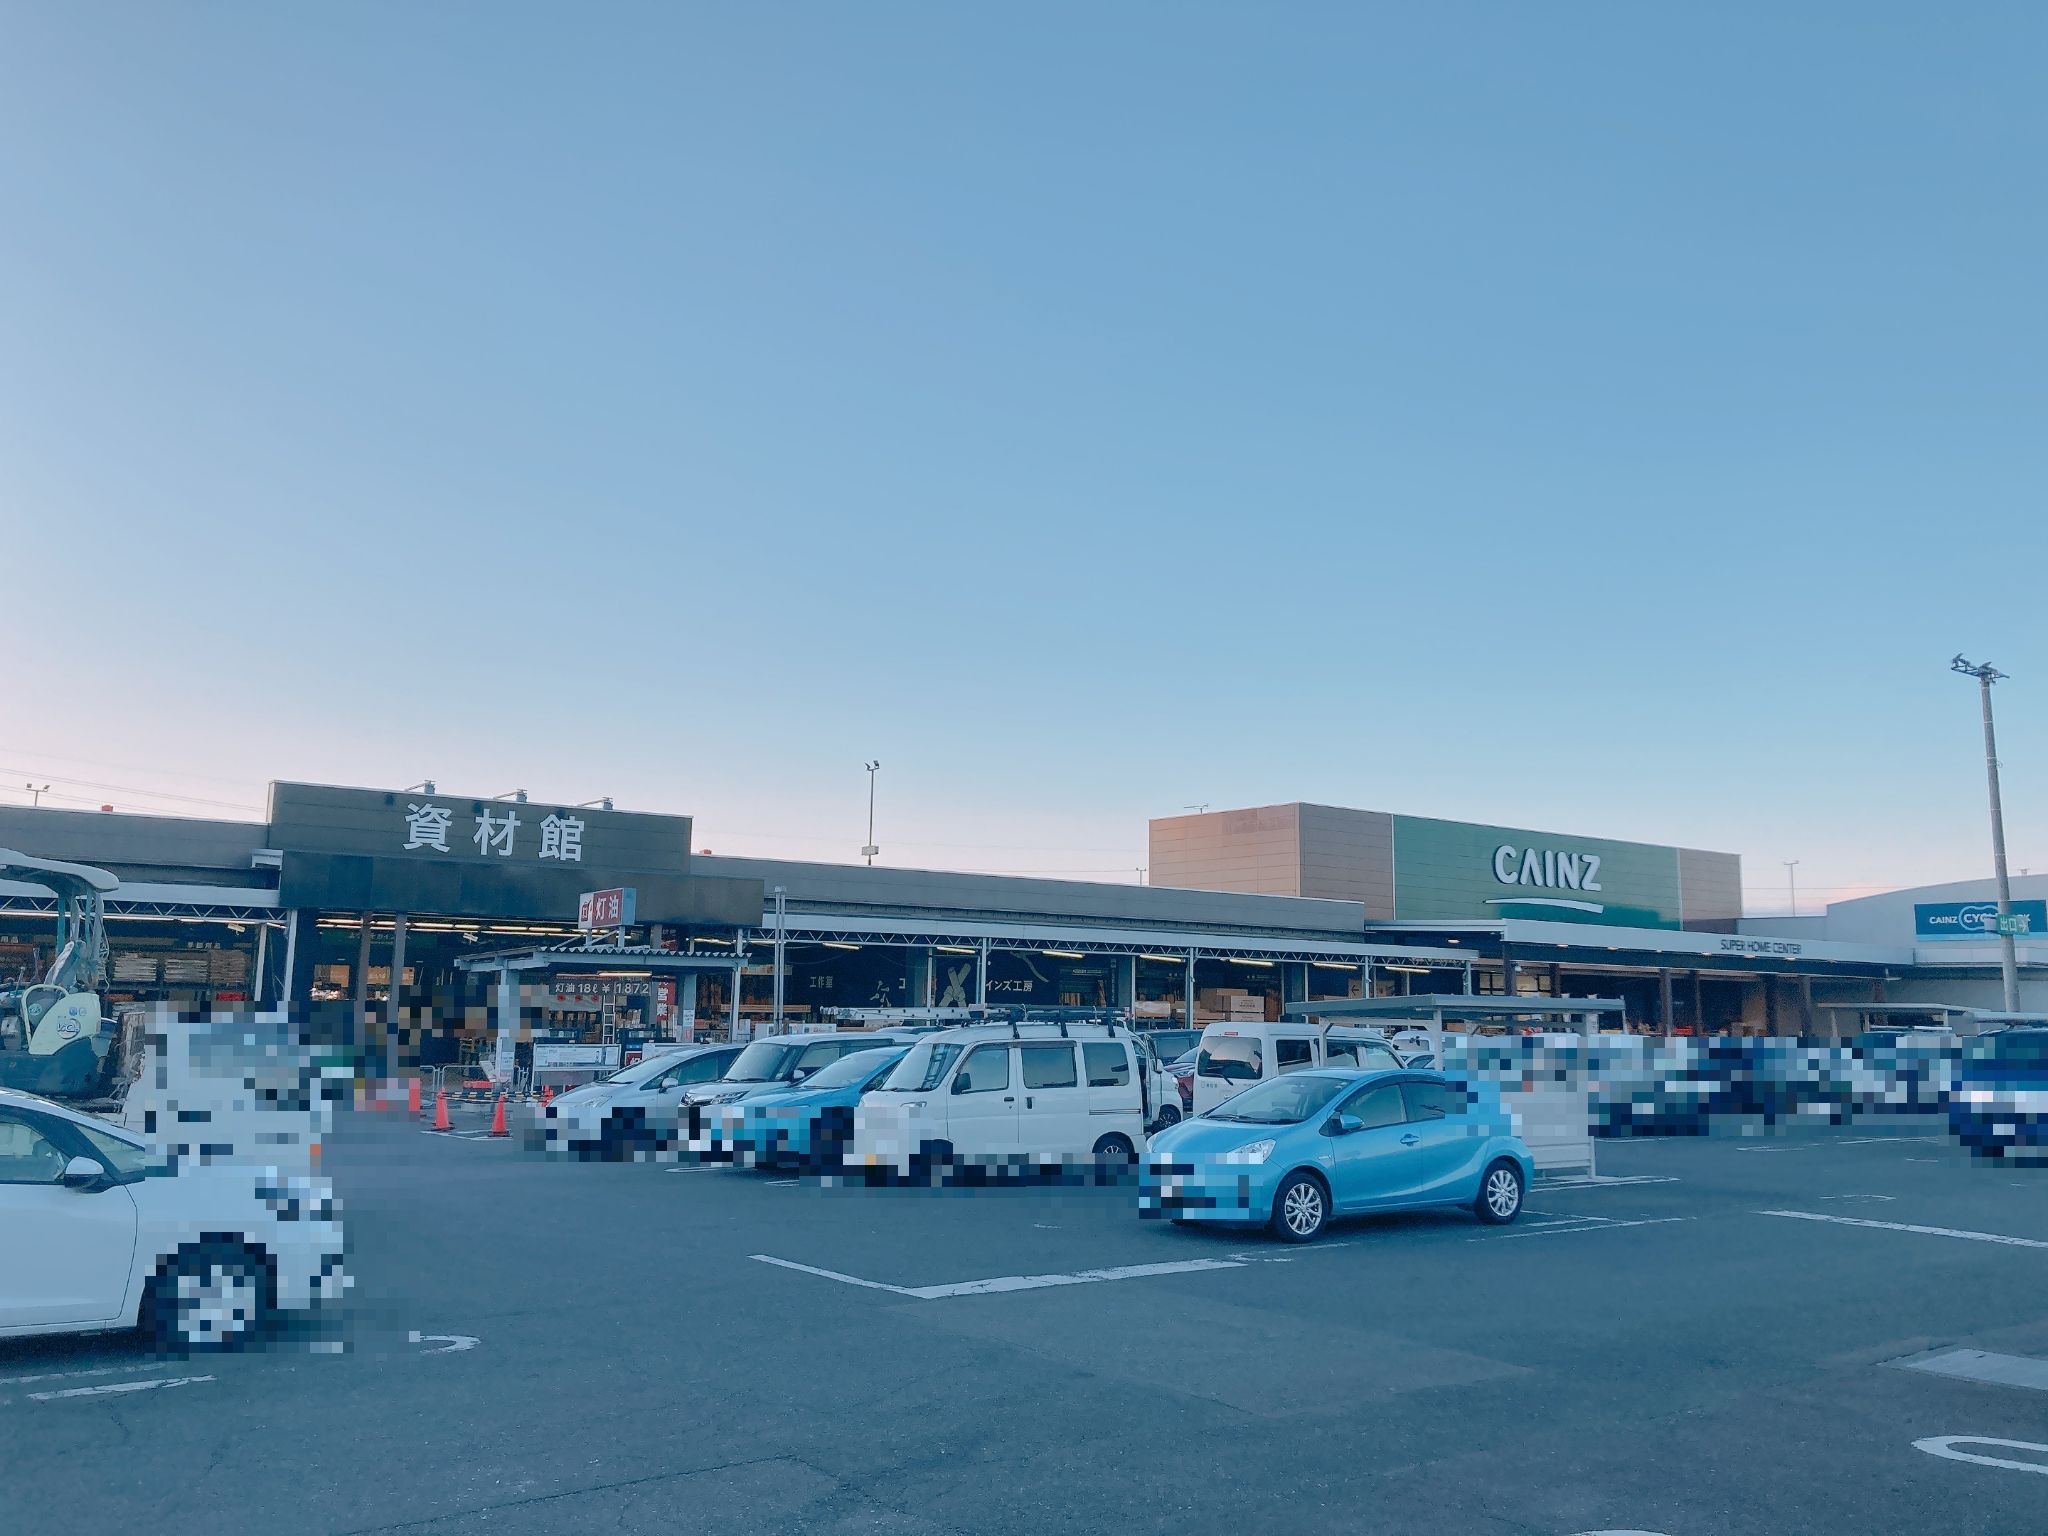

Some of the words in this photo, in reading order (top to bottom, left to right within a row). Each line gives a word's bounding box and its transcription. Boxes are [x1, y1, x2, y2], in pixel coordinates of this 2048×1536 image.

[402, 803, 585, 861] 資材館
[1493, 845, 1602, 892] CAINZ
[596, 895, 619, 920] 灯油
[1929, 916, 1959, 925] CAINZ
[1721, 939, 1744, 951] SUPER
[1745, 941, 1771, 953] HOME
[1773, 942, 1802, 955] CENTER
